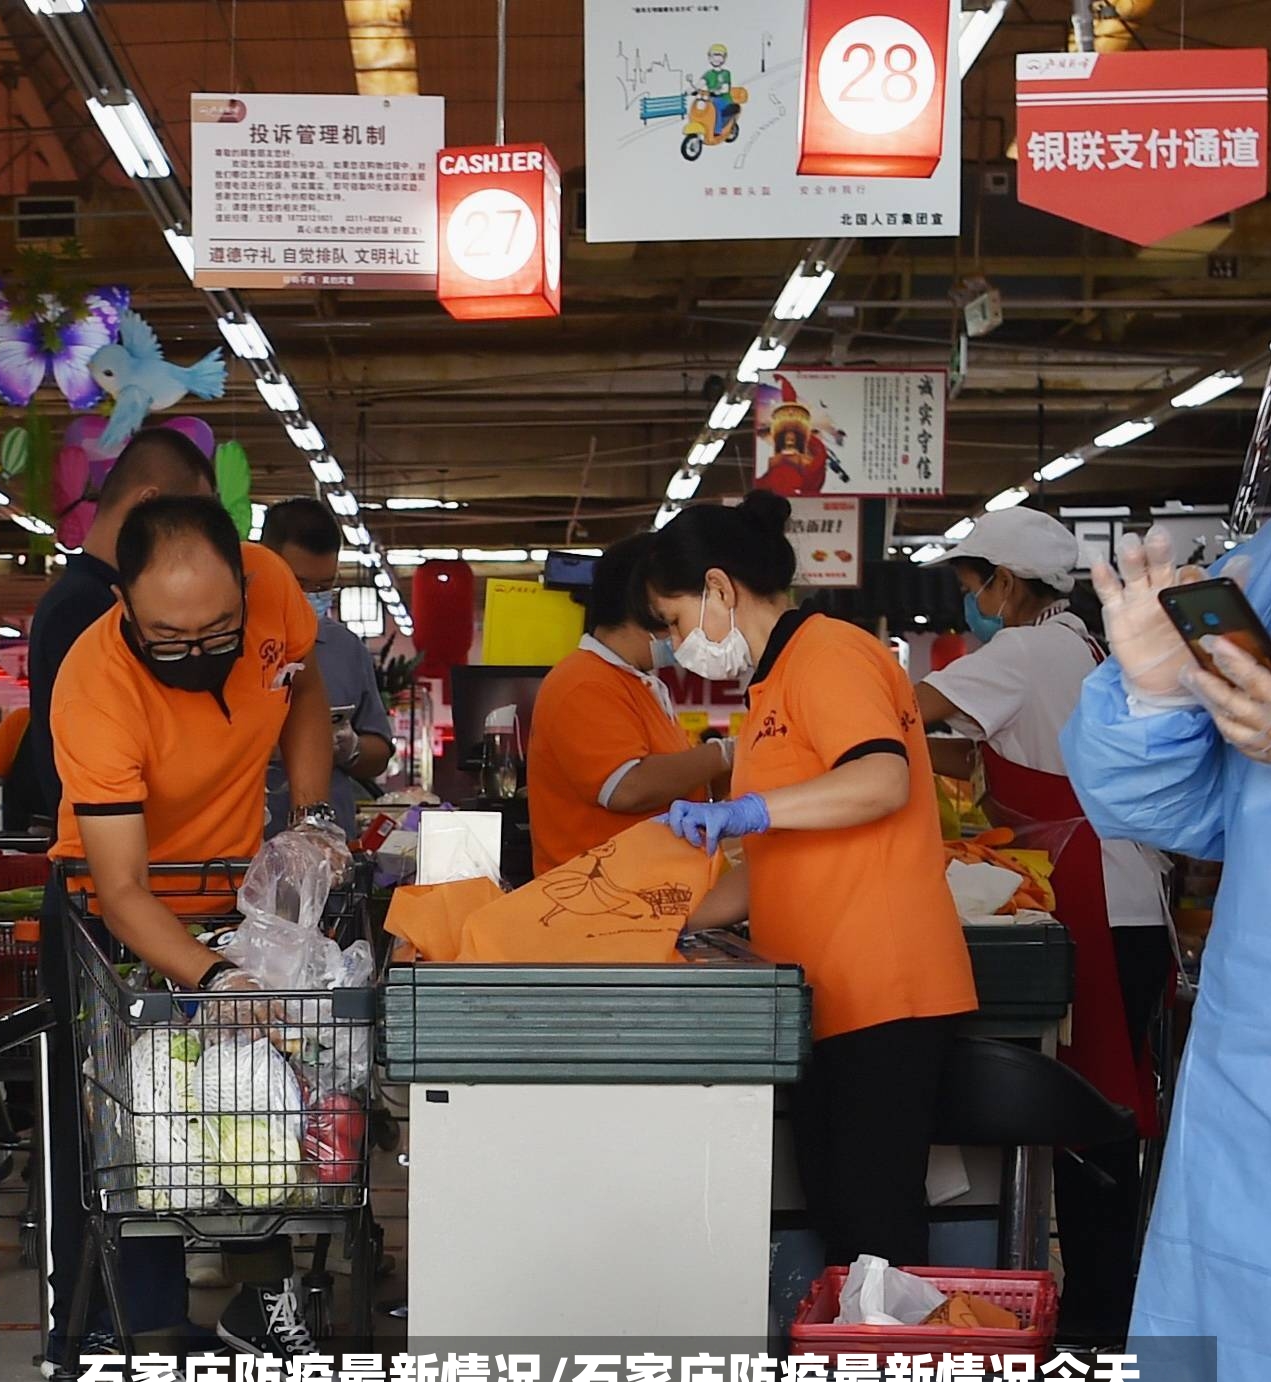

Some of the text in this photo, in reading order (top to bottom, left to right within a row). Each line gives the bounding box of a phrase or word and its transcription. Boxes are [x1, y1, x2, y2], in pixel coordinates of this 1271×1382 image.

[839, 42, 918, 103] 28
[249, 123, 386, 146] 投诉管理机制
[1027, 127, 1260, 171] 银联支付通道
[439, 151, 543, 176] CASHIER
[840, 212, 944, 226] 北国人百集团宣
[463, 208, 522, 258] 27
[283, 247, 348, 264] 自觉排队
[354, 247, 420, 265] 文明礼让
